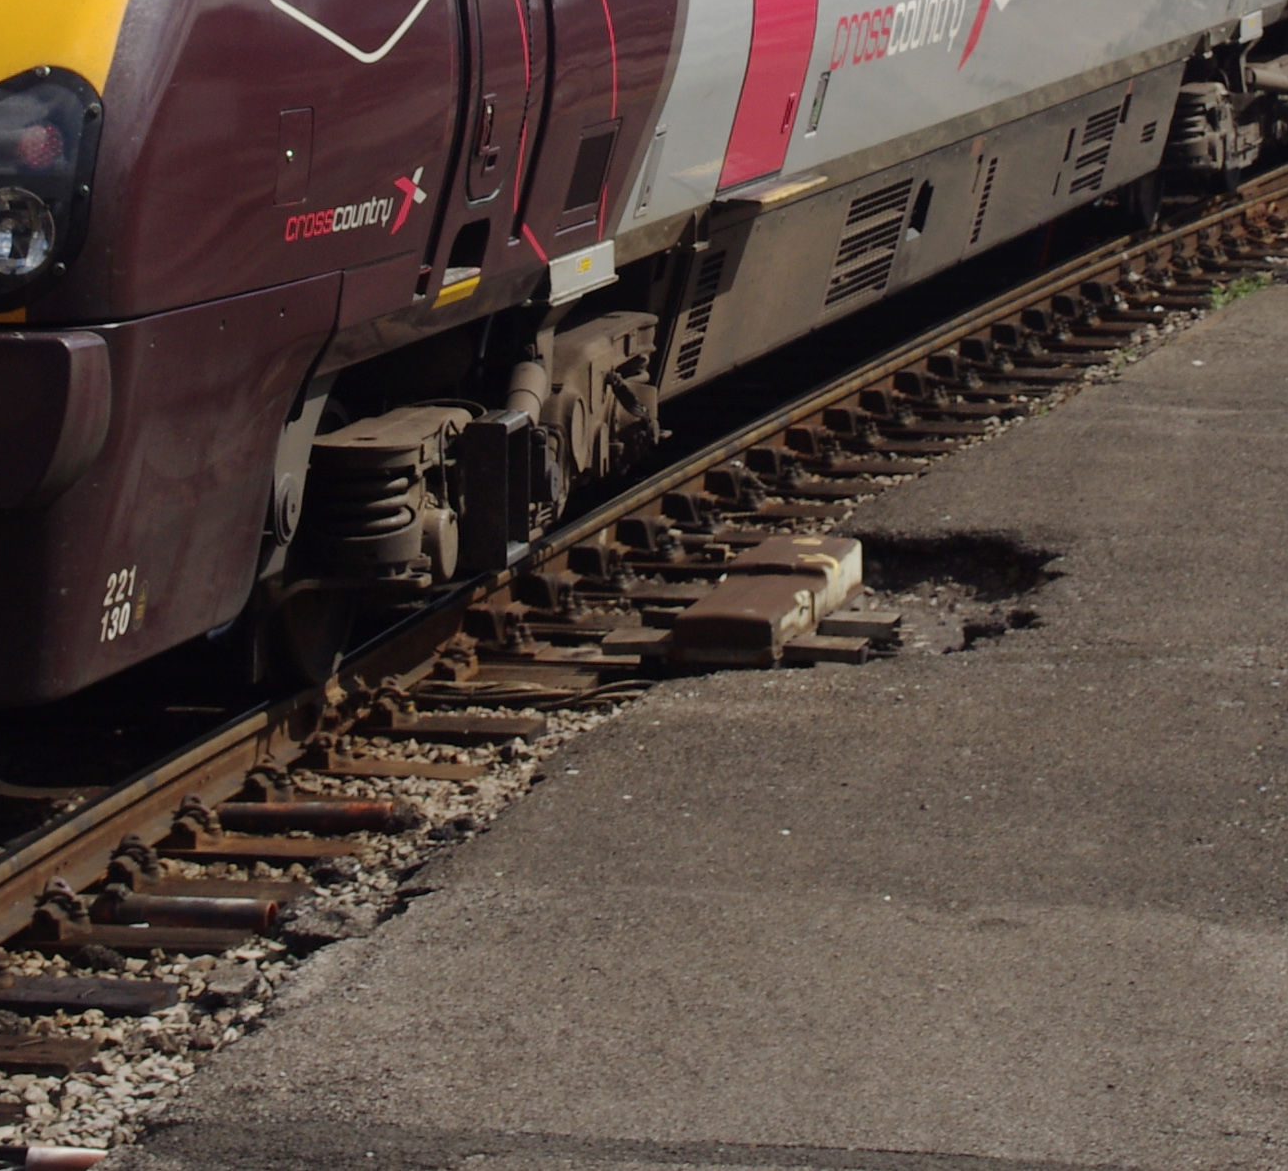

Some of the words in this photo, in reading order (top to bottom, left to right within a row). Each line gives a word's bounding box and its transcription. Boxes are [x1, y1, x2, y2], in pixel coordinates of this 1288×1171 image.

[284, 195, 394, 242] crosscountry
[103, 564, 137, 607] 221
[100, 601, 131, 643] 130
